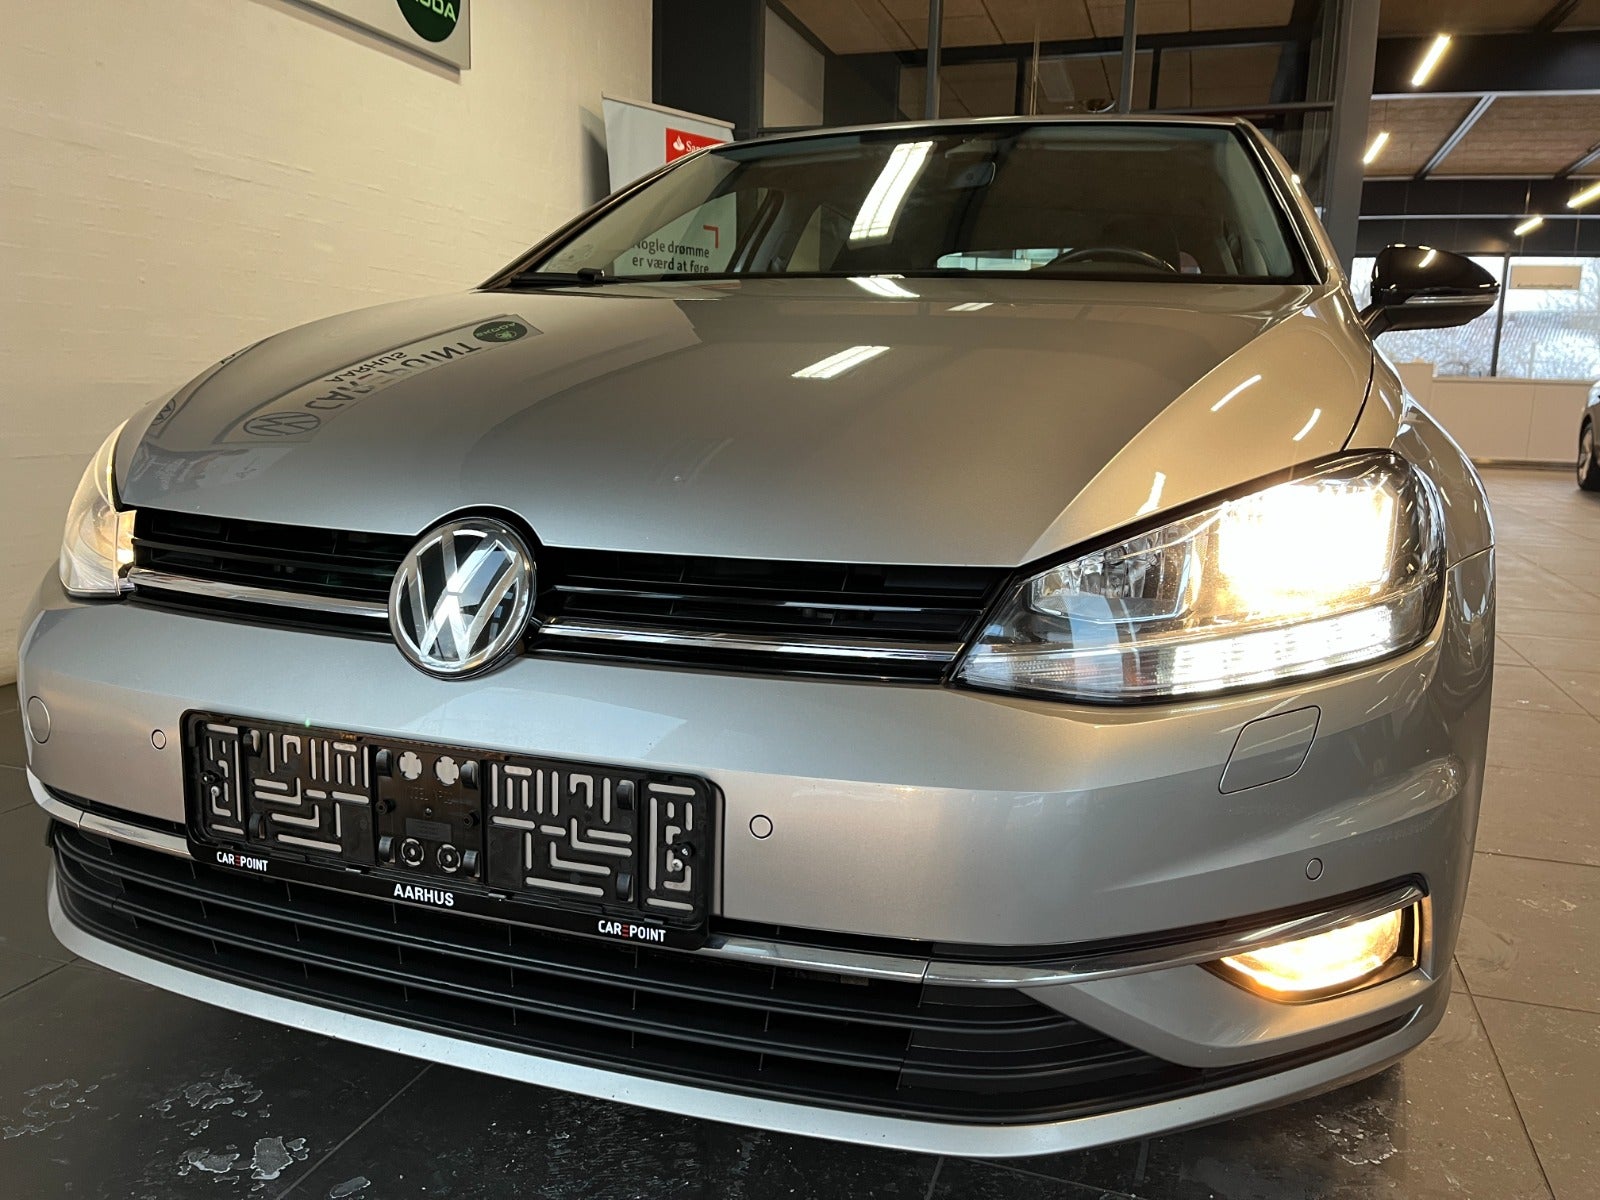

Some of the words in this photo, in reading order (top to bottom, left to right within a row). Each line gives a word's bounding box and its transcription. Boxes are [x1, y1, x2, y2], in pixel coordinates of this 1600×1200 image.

[668, 240, 710, 258] drømme
[632, 256, 644, 267] er
[647, 257, 675, 271] værd
[677, 260, 688, 272] at
[690, 260, 710, 273] føre
[393, 883, 455, 907] AARHUS
